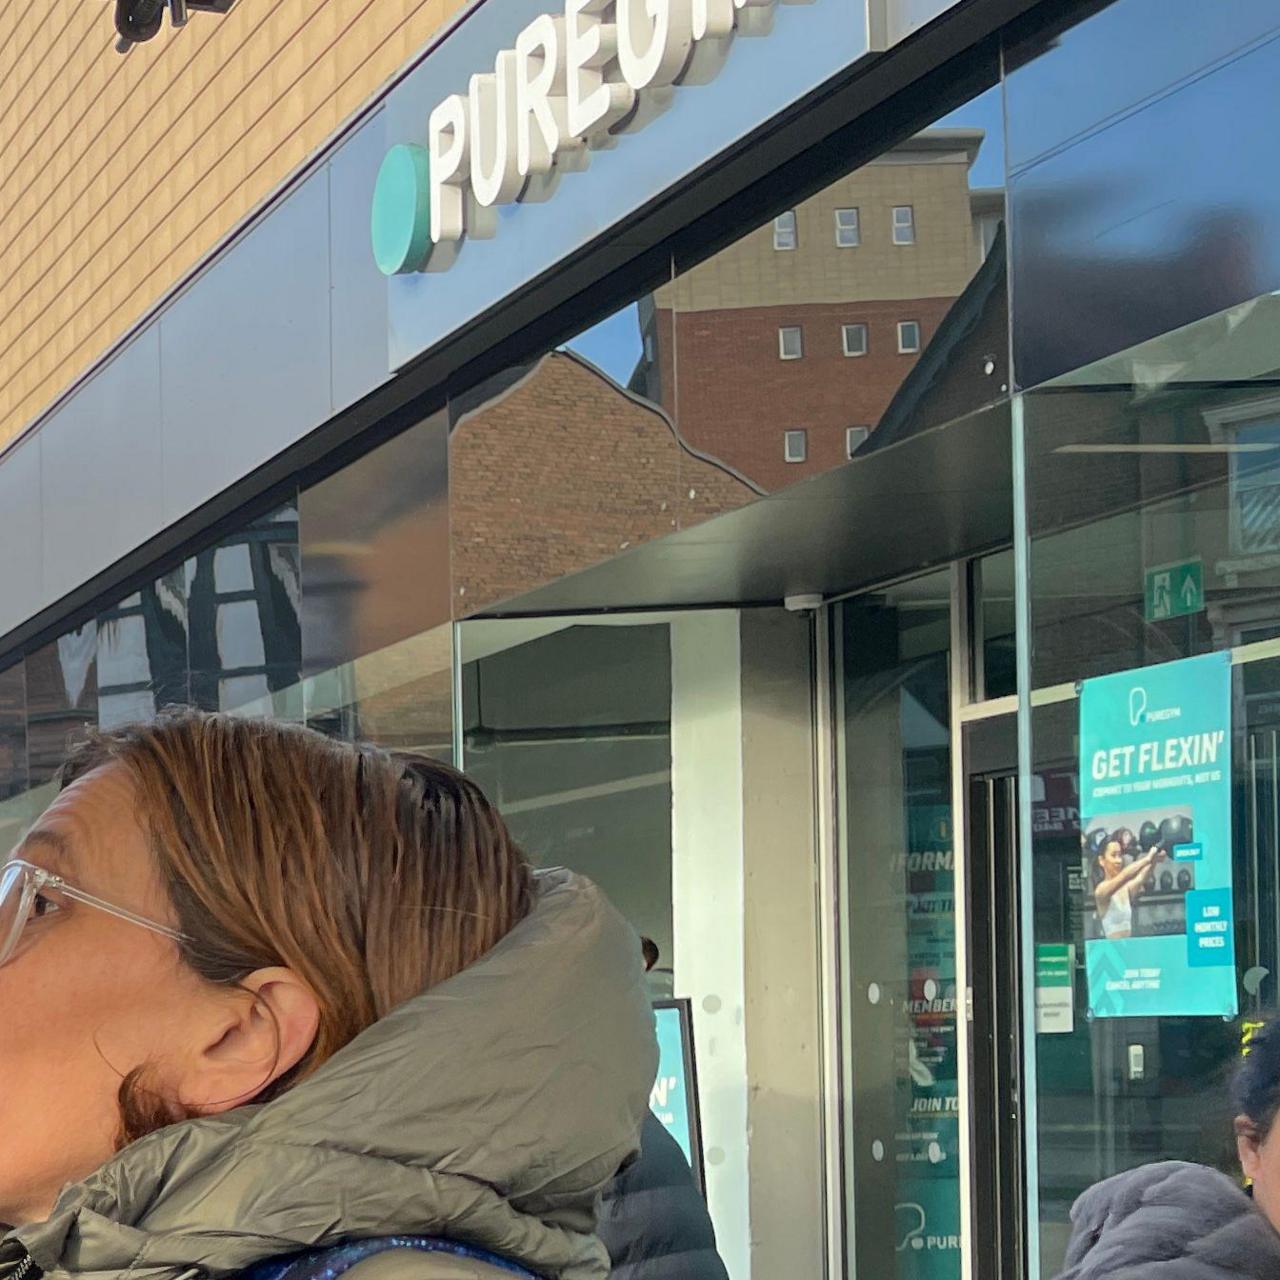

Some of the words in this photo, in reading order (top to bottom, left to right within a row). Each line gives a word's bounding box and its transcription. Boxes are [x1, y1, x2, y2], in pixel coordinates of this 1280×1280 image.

[1092, 745, 1136, 780] GET
[1138, 730, 1225, 774] FLEXIN'
[911, 1096, 942, 1112] JOIN
